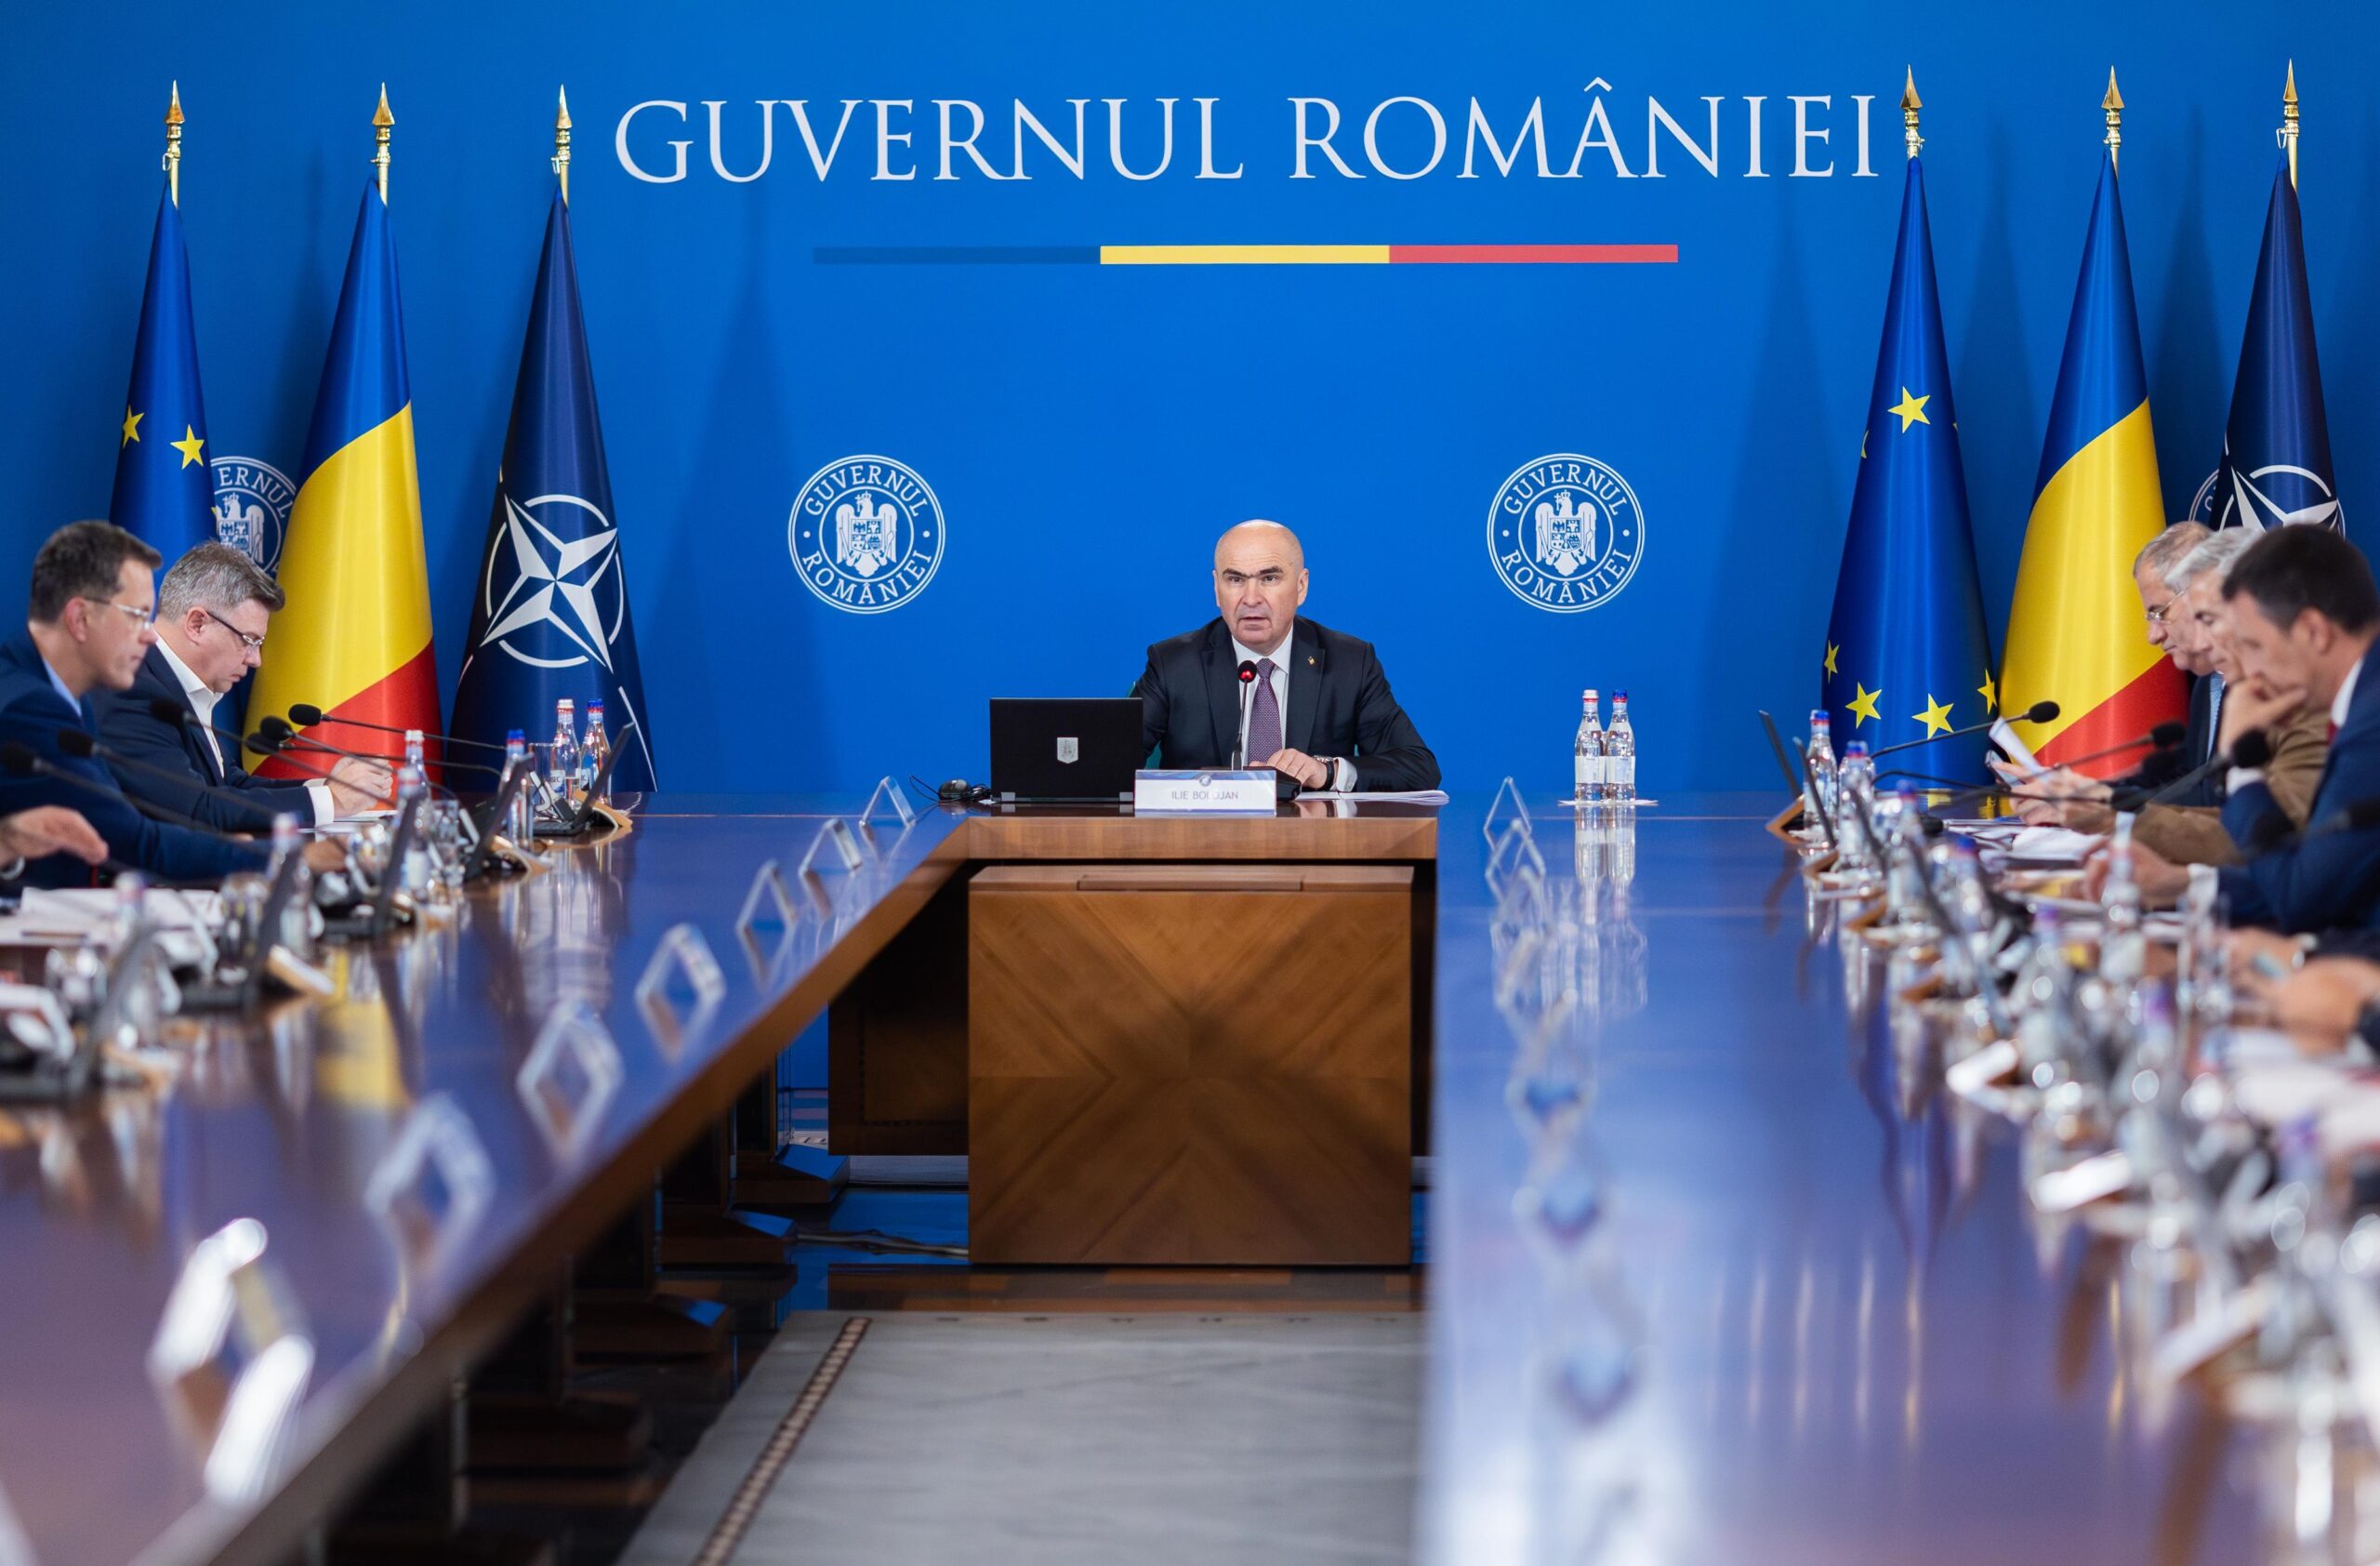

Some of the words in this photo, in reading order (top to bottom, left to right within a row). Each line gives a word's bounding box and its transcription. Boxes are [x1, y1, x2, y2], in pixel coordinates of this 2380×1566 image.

[616, 98, 1243, 183] GUVERNUL
[1288, 76, 1879, 180] ROMÂNIEI
[217, 466, 294, 519] ERNUL
[805, 464, 928, 517] GUVERNUL
[1503, 463, 1627, 516] GUVERNUL
[802, 551, 932, 604] ROMÂNIEI
[1501, 549, 1631, 604] ROMÂNIEI
[1171, 790, 1189, 800] ILIE
